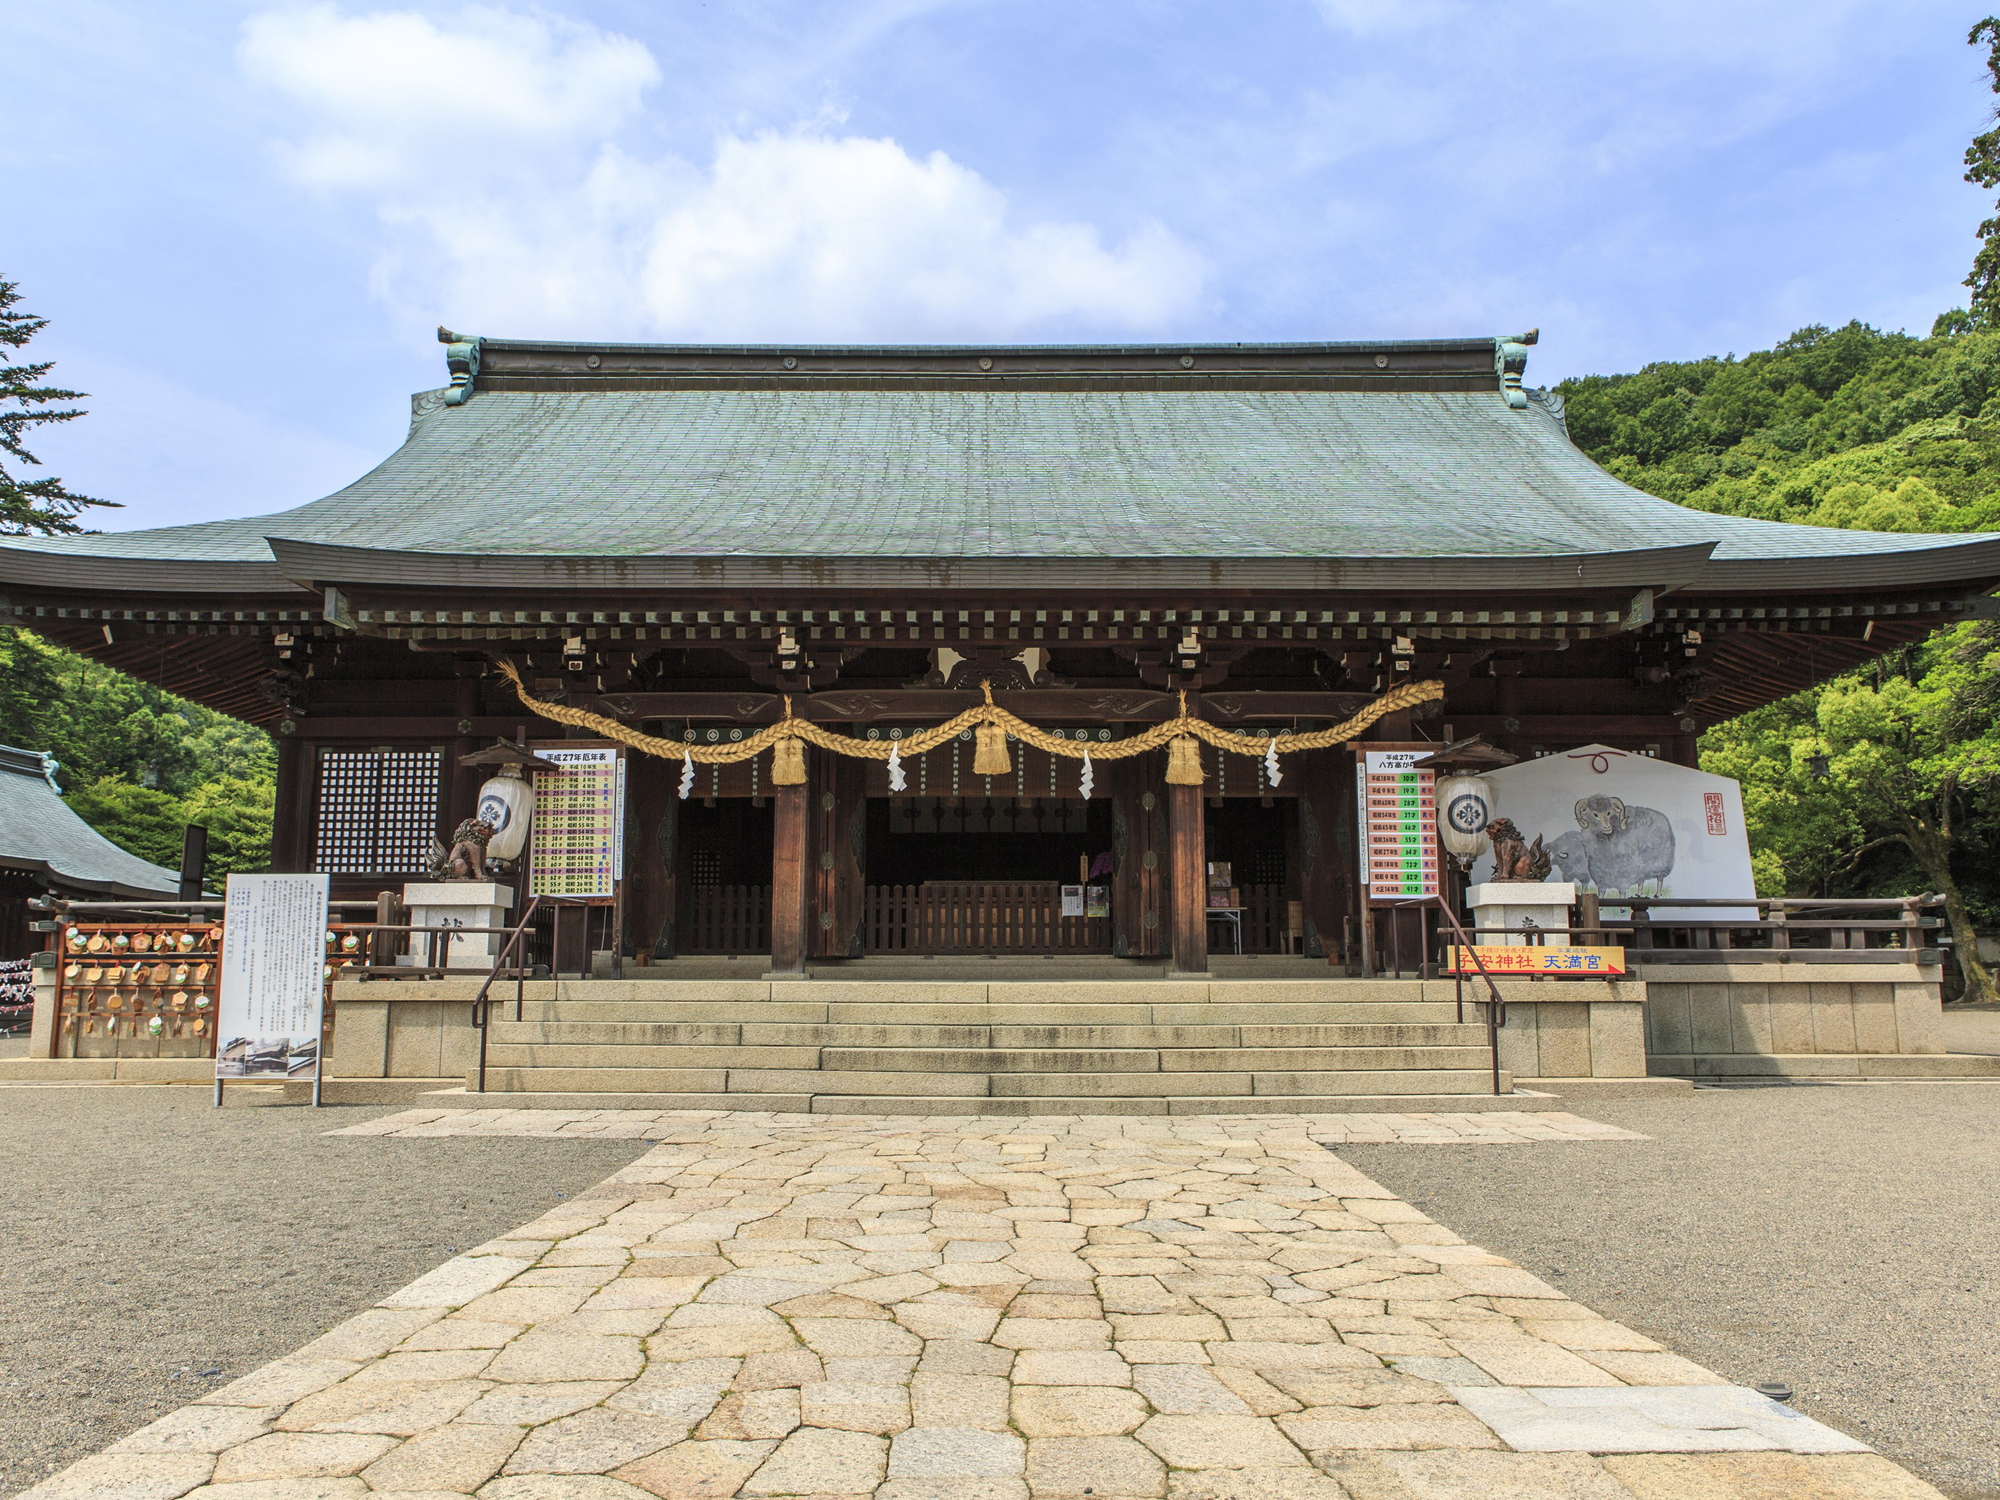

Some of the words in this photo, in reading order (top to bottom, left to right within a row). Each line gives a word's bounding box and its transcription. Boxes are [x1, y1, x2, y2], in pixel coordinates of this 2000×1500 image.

[546, 753, 607, 761] 平成27年厄年表
[1460, 954, 1535, 968] 子安神社
[1544, 954, 1601, 969] 天満宮
